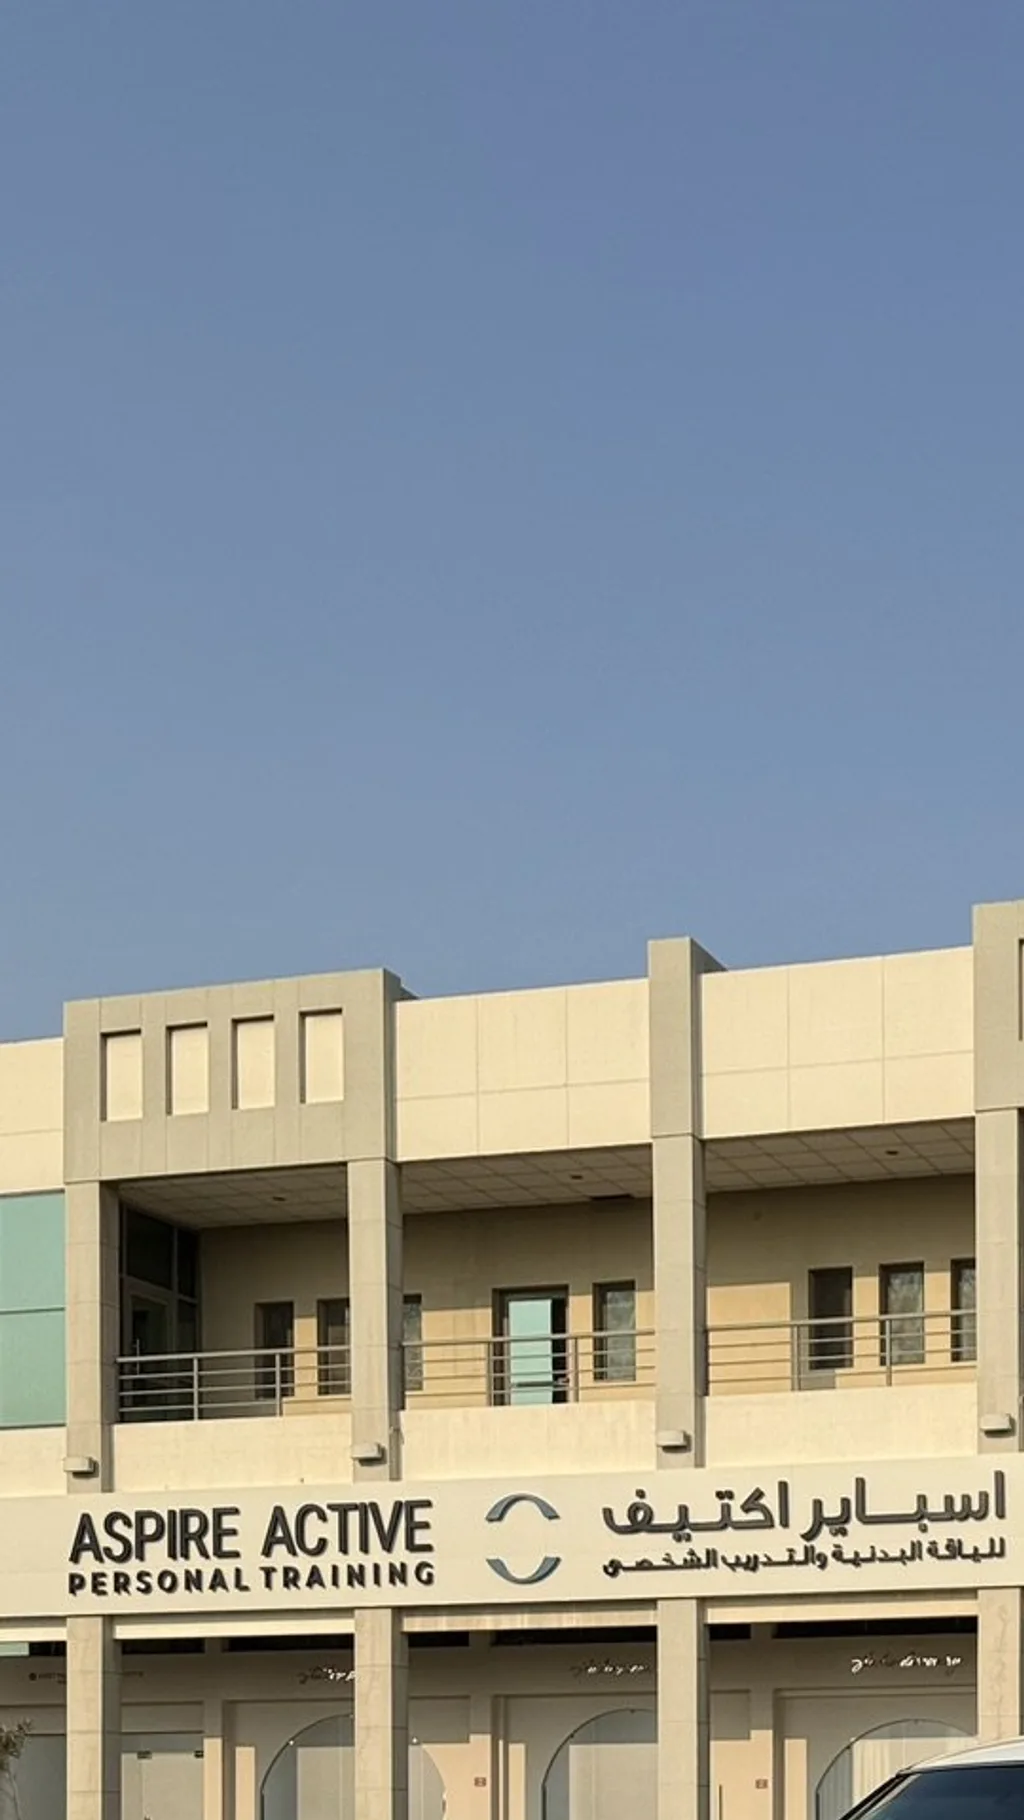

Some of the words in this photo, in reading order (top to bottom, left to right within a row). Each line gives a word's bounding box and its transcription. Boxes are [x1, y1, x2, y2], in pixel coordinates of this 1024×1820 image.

[69, 1506, 240, 1564] ASPIRE
[261, 1499, 433, 1557] ACTIVE
[602, 1481, 790, 1543] اكتيف
[801, 1470, 1007, 1541] اسباير
[67, 1568, 251, 1596] PERSONAL
[259, 1560, 435, 1591] TRAINING
